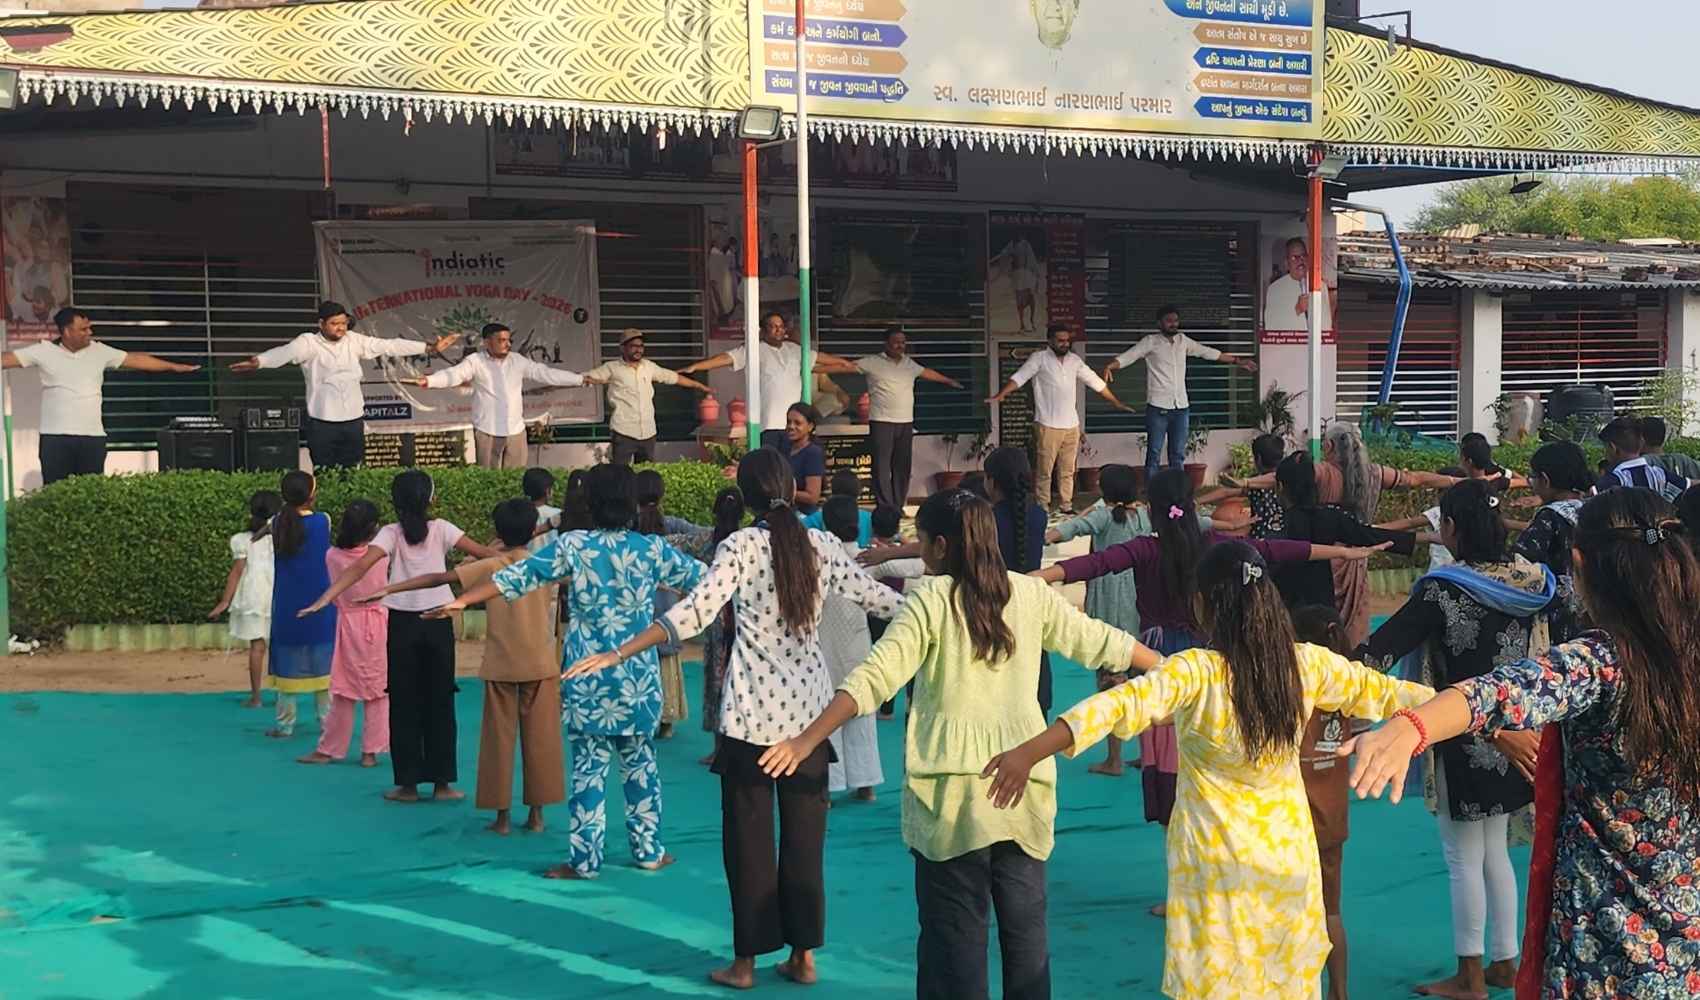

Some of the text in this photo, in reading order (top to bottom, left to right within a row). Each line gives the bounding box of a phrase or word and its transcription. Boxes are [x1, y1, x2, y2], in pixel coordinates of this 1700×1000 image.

[1054, 91, 1125, 111] નારણભાઈ
[1129, 97, 1173, 114] પરમાર
[364, 407, 408, 417] APITALZ
